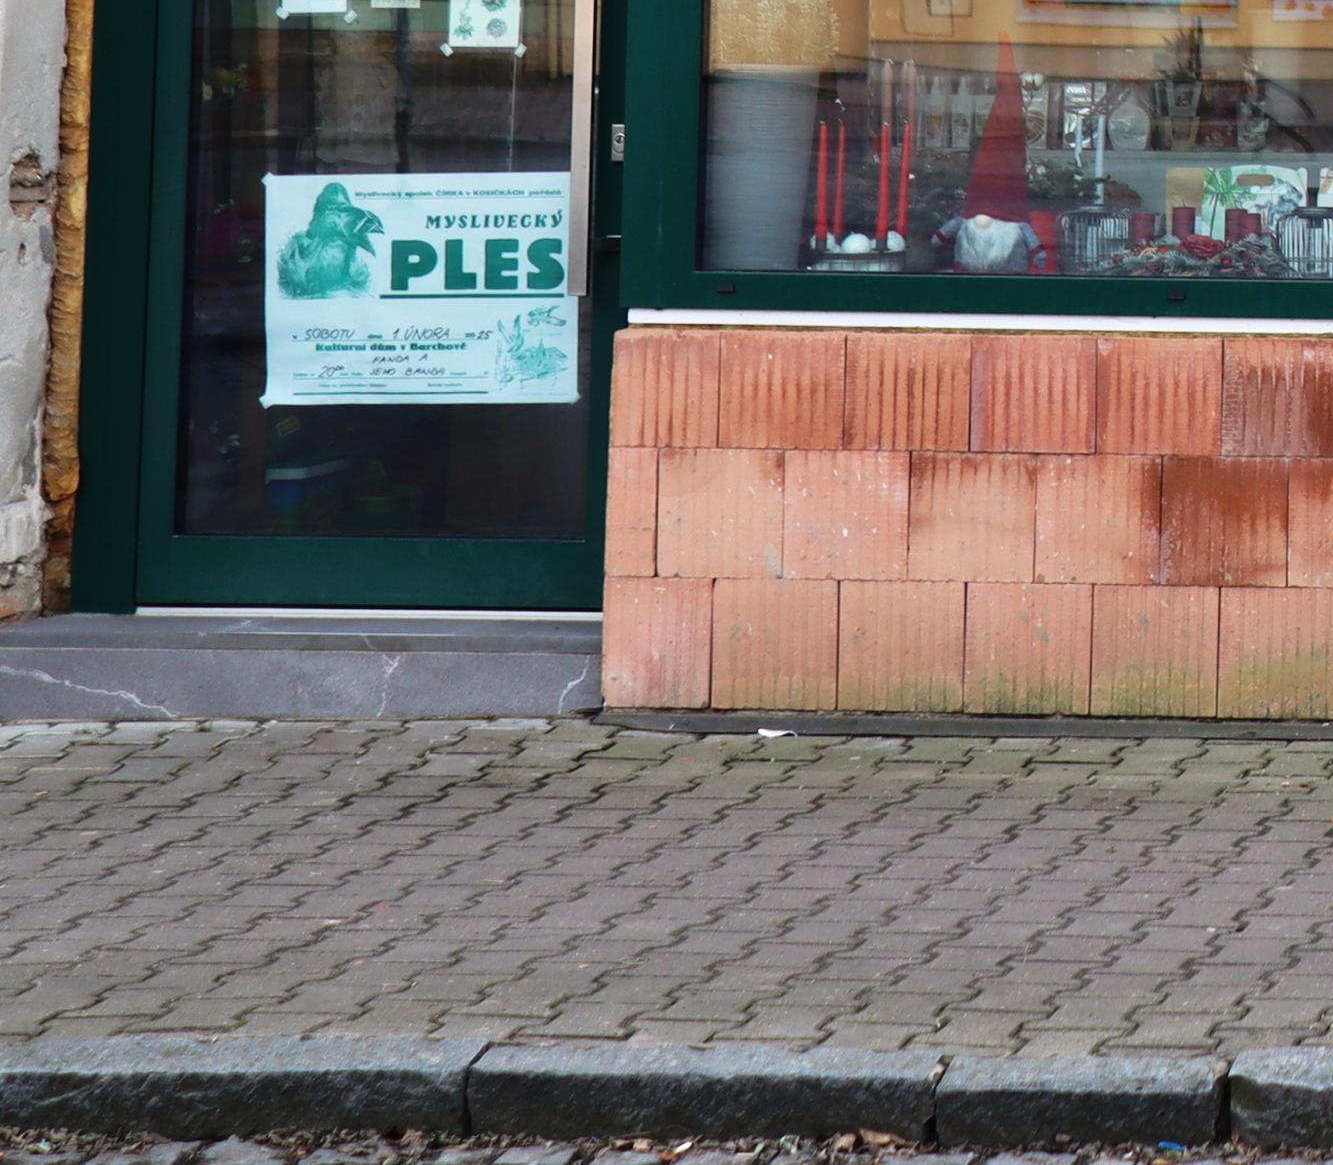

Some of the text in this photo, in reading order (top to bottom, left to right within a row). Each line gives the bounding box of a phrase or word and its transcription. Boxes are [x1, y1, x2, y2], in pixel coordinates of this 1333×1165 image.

[425, 210, 563, 229] MYSLIVECKÝ
[391, 238, 565, 291] PLES
[305, 328, 356, 341] SOBOTU
[404, 324, 451, 341] ÚNORA
[315, 343, 366, 351] Kulturní
[370, 343, 396, 351] dům
